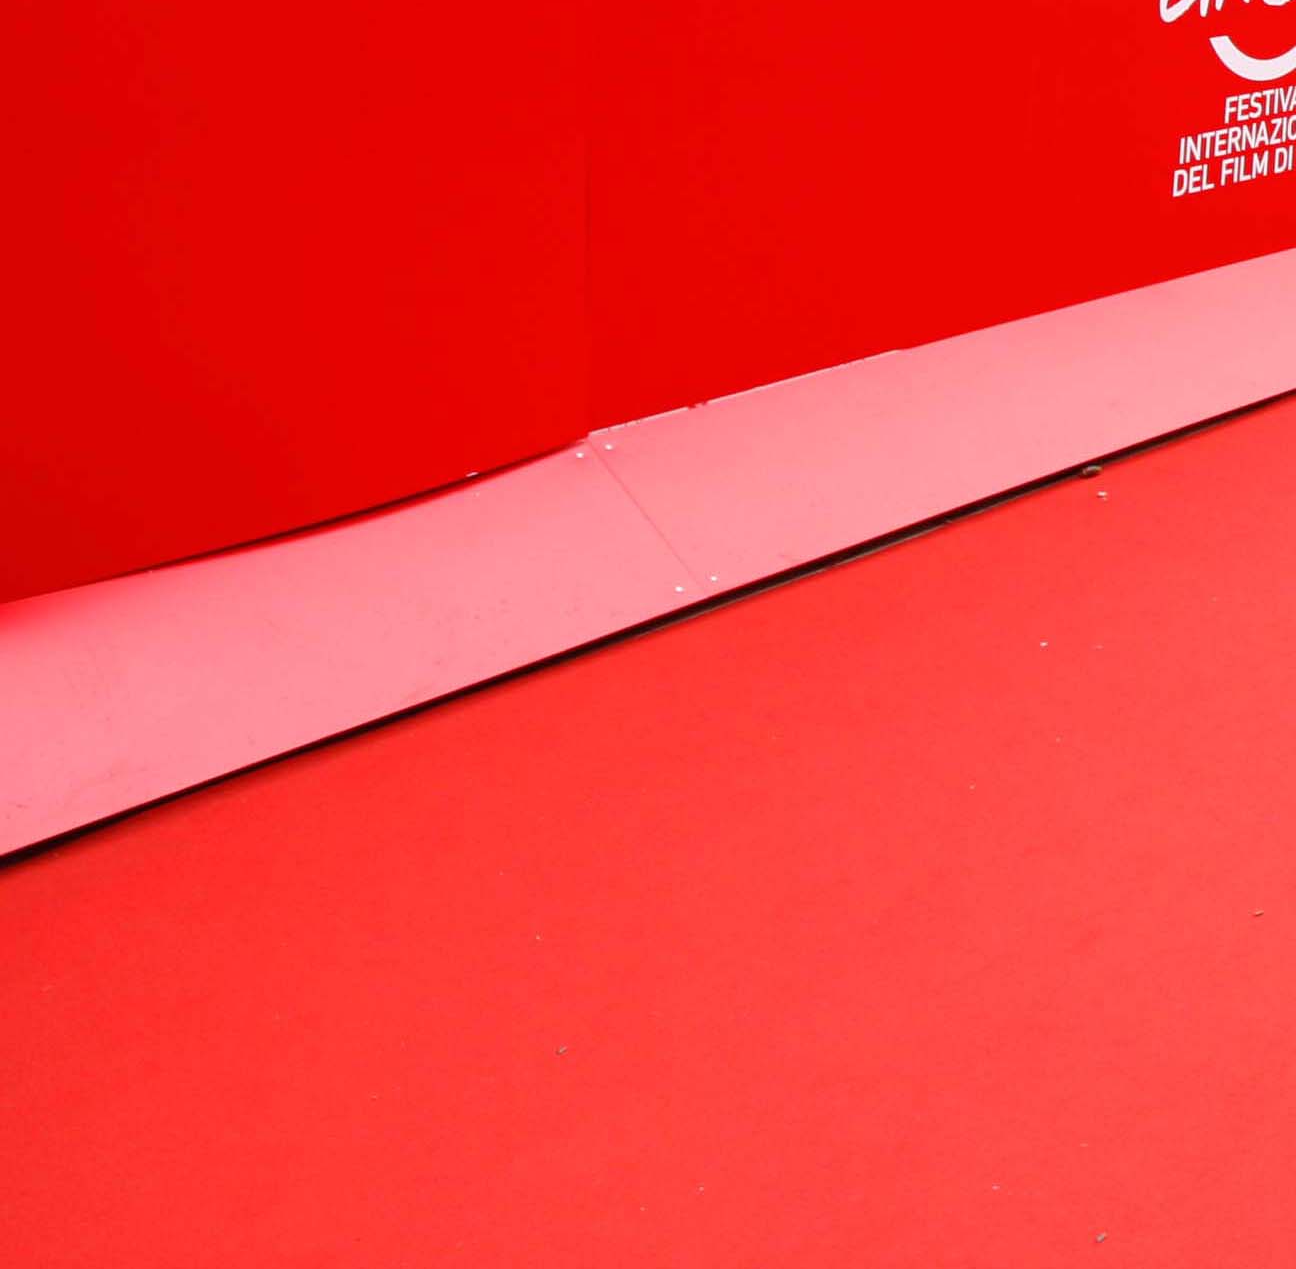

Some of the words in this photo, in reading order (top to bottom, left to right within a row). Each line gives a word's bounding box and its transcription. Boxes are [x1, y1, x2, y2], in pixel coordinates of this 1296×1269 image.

[1172, 164, 1215, 198] DEL
[1220, 151, 1269, 187] FILM
[1273, 146, 1294, 173] DI
